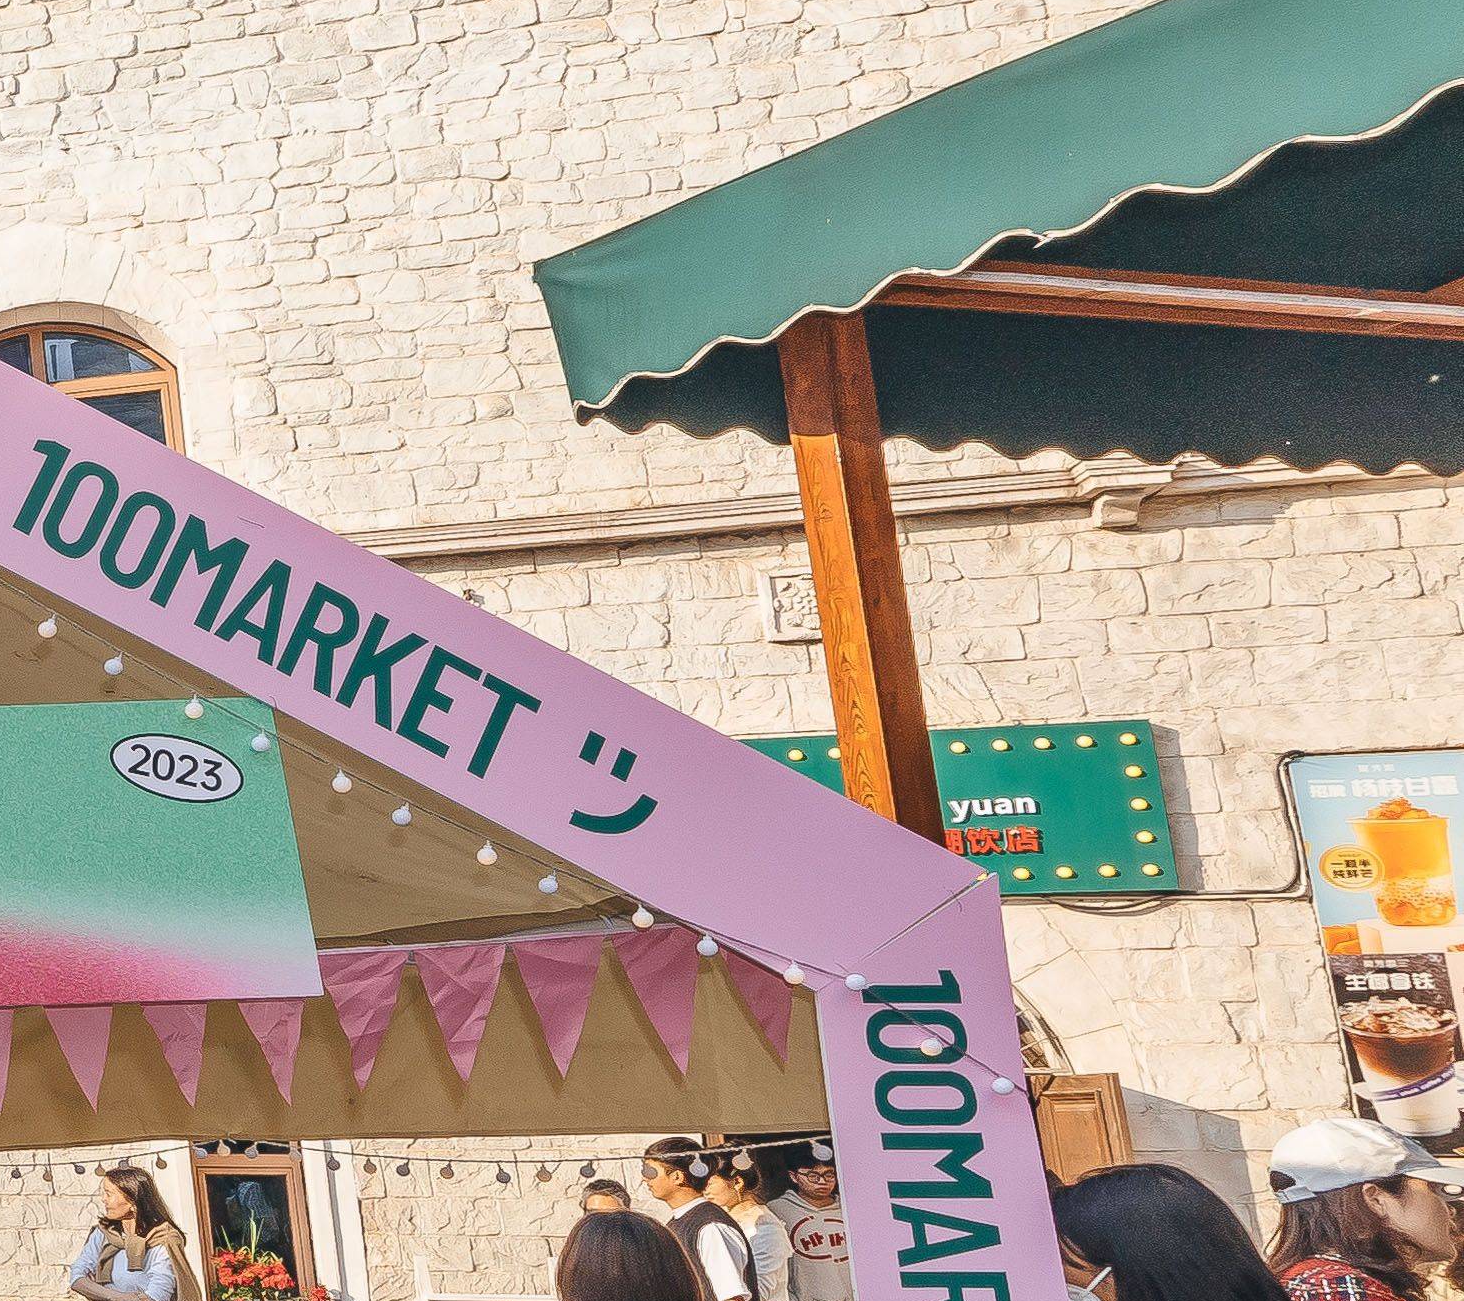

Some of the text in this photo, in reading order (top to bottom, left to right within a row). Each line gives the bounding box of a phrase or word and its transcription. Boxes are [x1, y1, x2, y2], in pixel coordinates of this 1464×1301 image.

[12, 439, 541, 779] 100MARKET
[128, 742, 224, 792] 2023
[947, 796, 1037, 824] yuan
